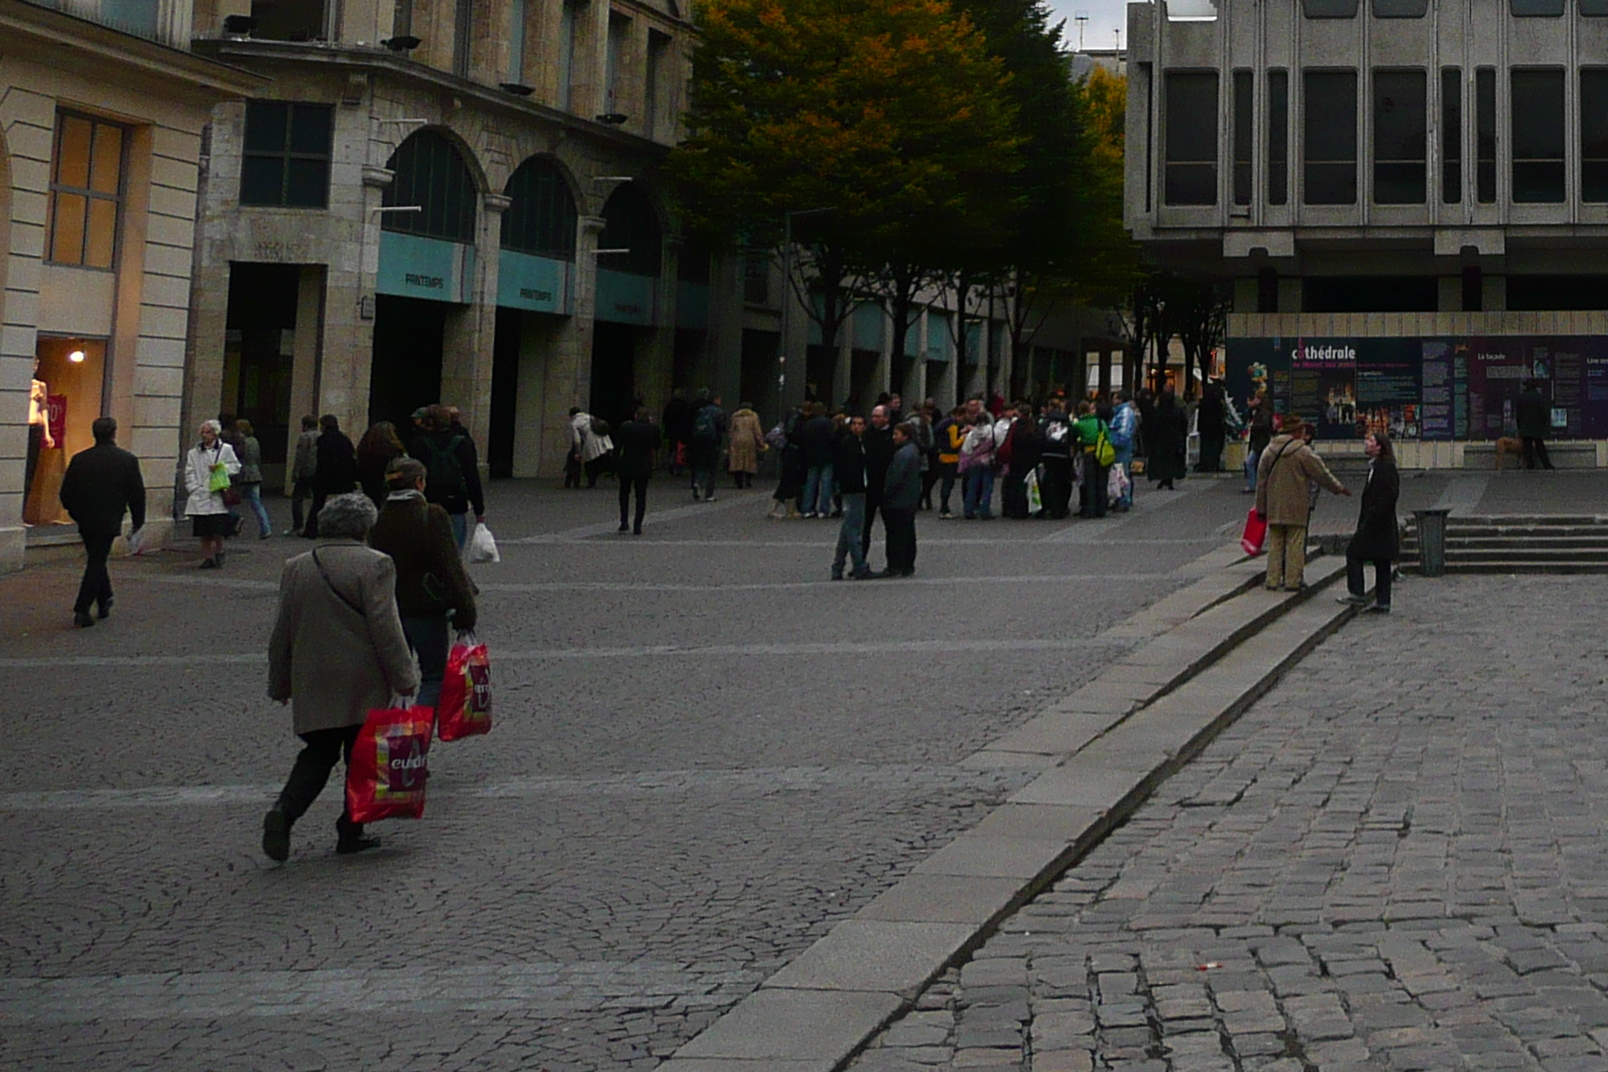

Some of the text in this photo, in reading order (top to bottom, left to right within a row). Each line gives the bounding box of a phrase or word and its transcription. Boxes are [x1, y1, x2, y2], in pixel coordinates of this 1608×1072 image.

[405, 273, 444, 289] PRINTEMPS
[520, 288, 552, 302] PRINTEMPS
[1291, 344, 1356, 360] cathédrale
